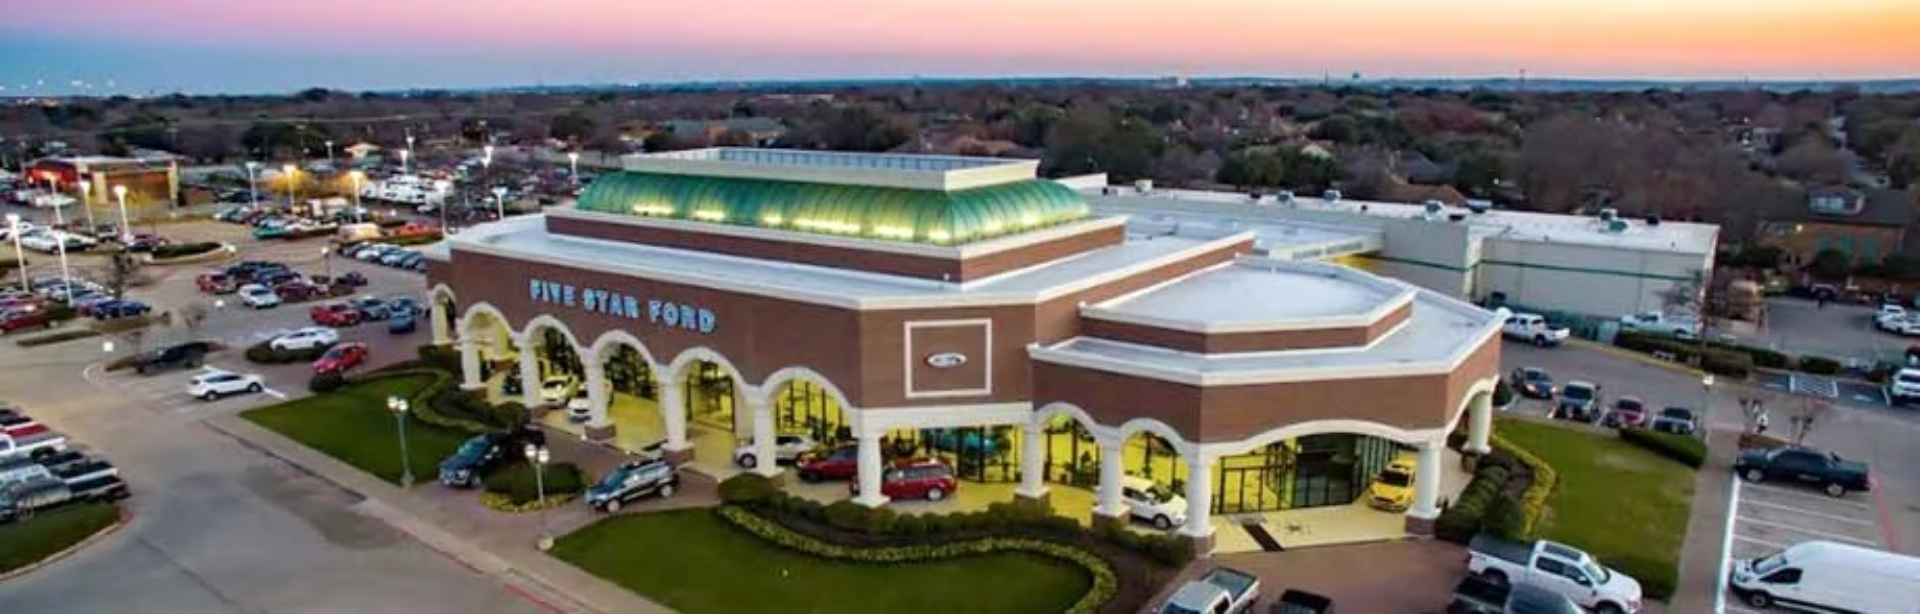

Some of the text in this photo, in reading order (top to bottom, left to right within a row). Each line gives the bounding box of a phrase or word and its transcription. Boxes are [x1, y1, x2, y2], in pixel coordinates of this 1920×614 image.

[529, 279, 715, 333] FIVE STAR FORD
